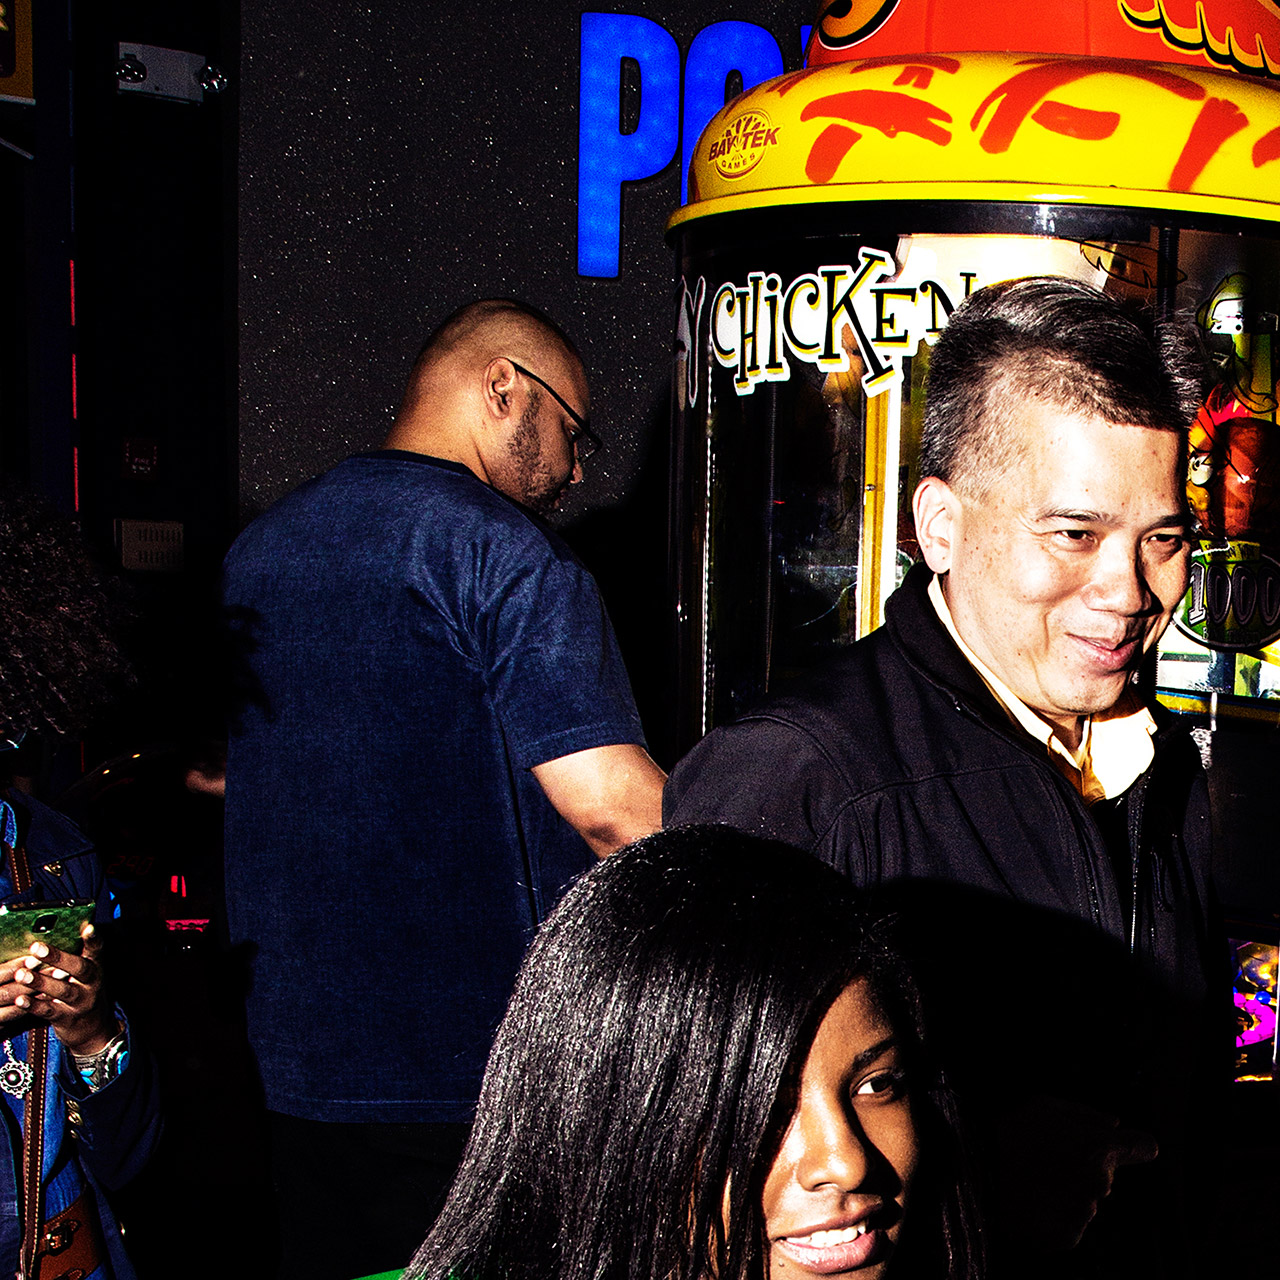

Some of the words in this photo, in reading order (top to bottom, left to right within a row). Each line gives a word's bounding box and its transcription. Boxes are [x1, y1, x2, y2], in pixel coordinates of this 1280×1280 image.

[708, 136, 737, 161] BAY
[742, 127, 781, 151] TEK
[721, 152, 757, 170] GAMES
